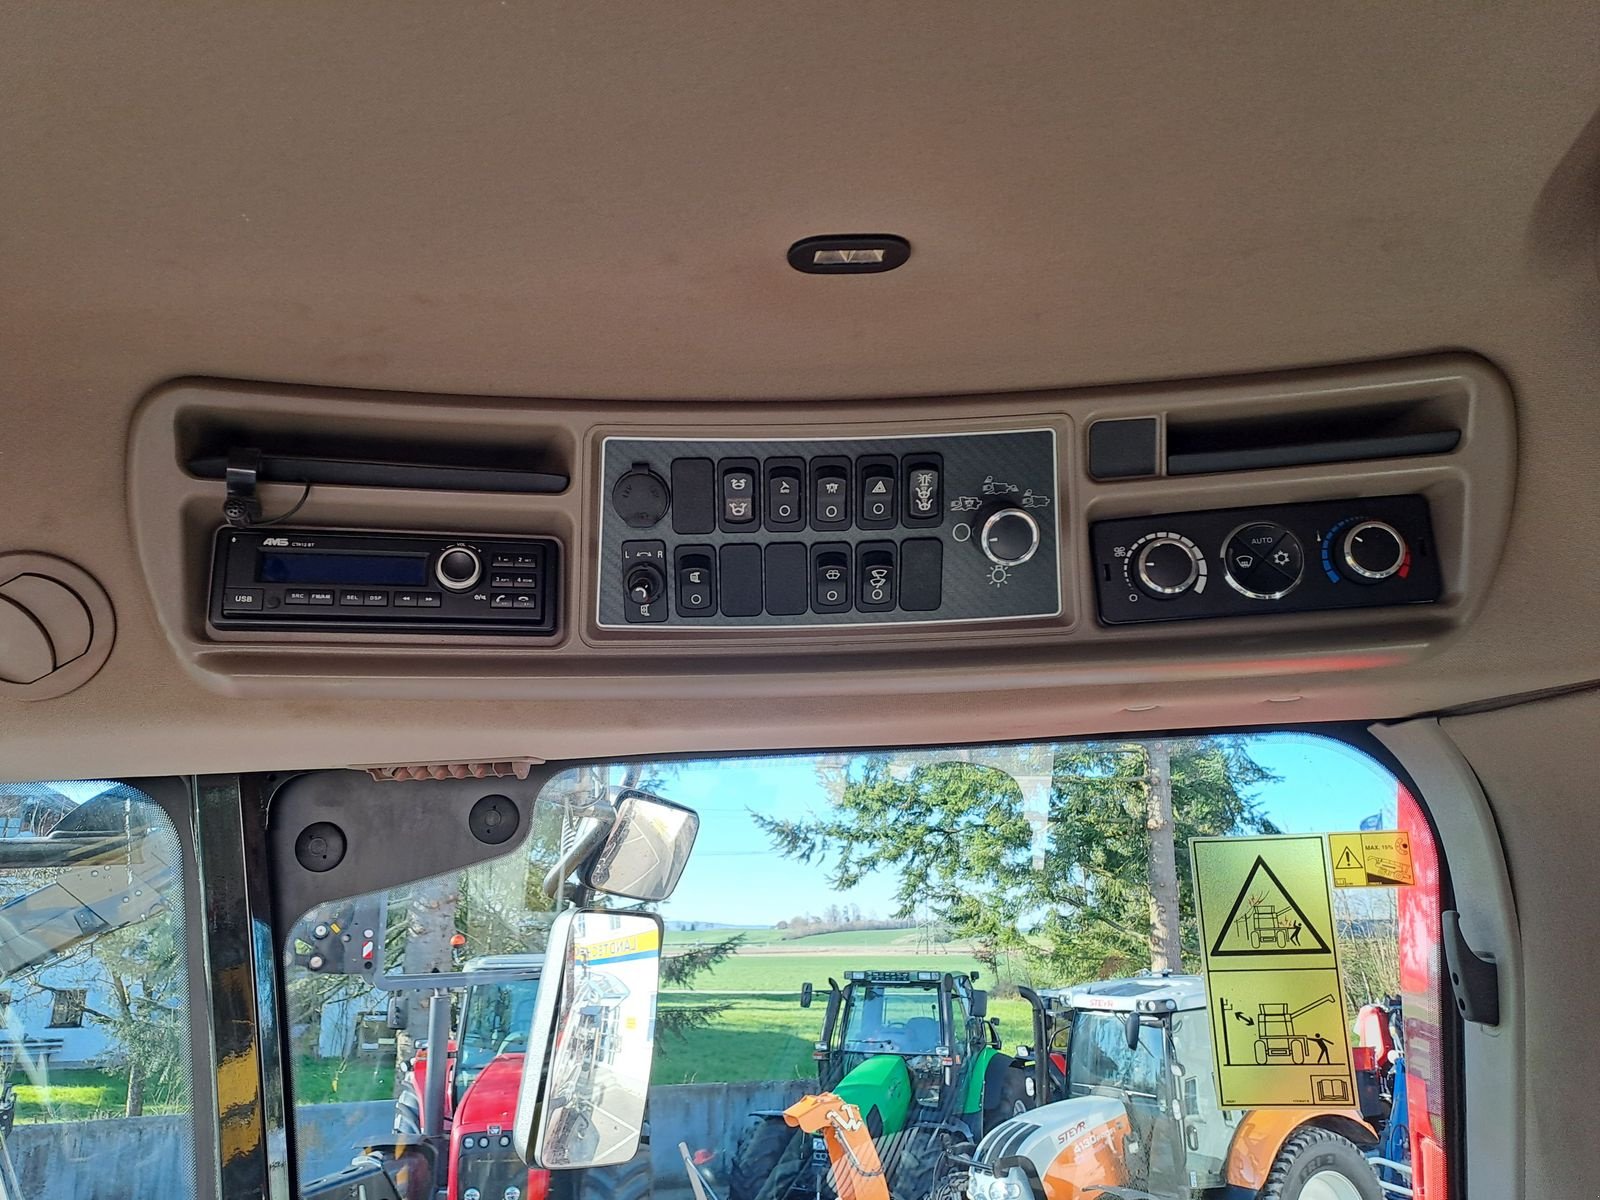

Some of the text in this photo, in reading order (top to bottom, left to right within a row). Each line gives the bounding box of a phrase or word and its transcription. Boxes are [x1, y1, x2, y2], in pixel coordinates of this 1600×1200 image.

[1251, 535, 1273, 545] AUTO
[625, 551, 630, 559] L
[657, 550, 663, 559] R
[235, 595, 253, 603] USB
[1089, 998, 1114, 1008] STEYR
[1057, 1120, 1086, 1145] STEYR
